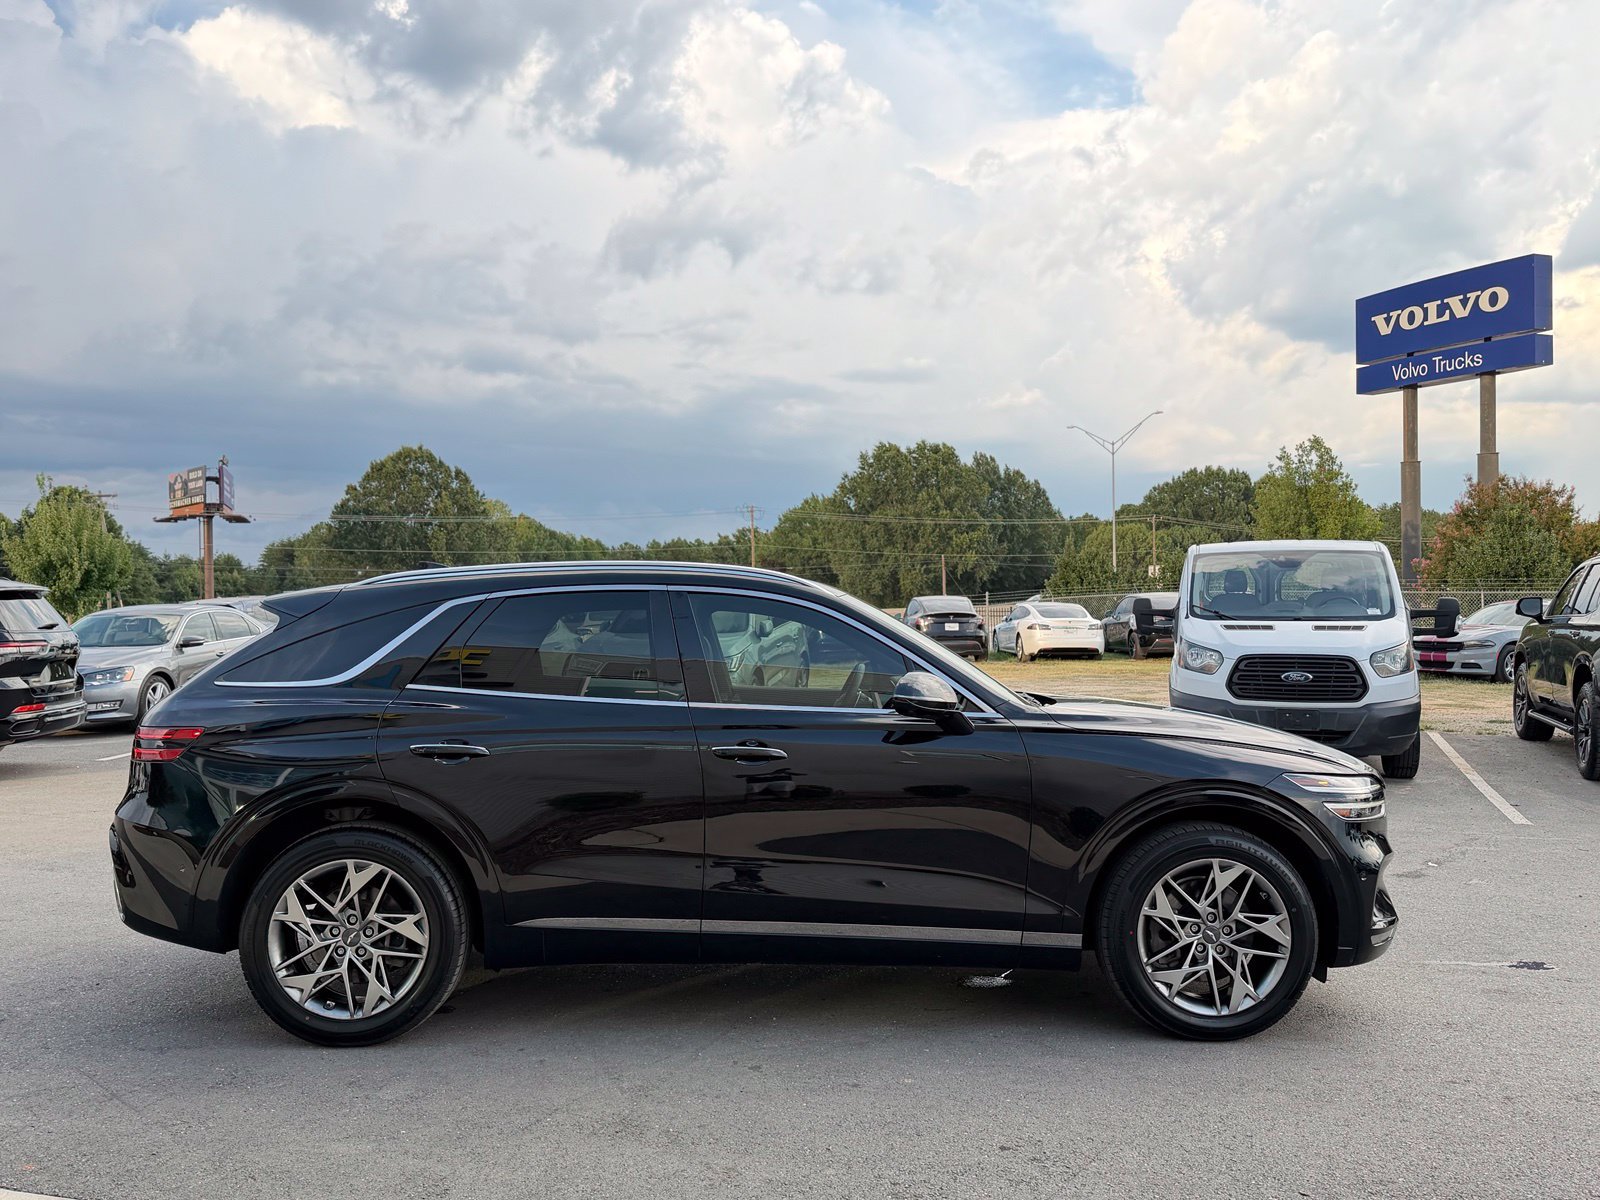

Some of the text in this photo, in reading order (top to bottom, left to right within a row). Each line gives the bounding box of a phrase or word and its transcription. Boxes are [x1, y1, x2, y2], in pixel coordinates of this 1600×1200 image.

[1371, 286, 1509, 336] VOLVO
[1392, 351, 1483, 381] Volvo Trucks
[1288, 672, 1305, 682] Ford
